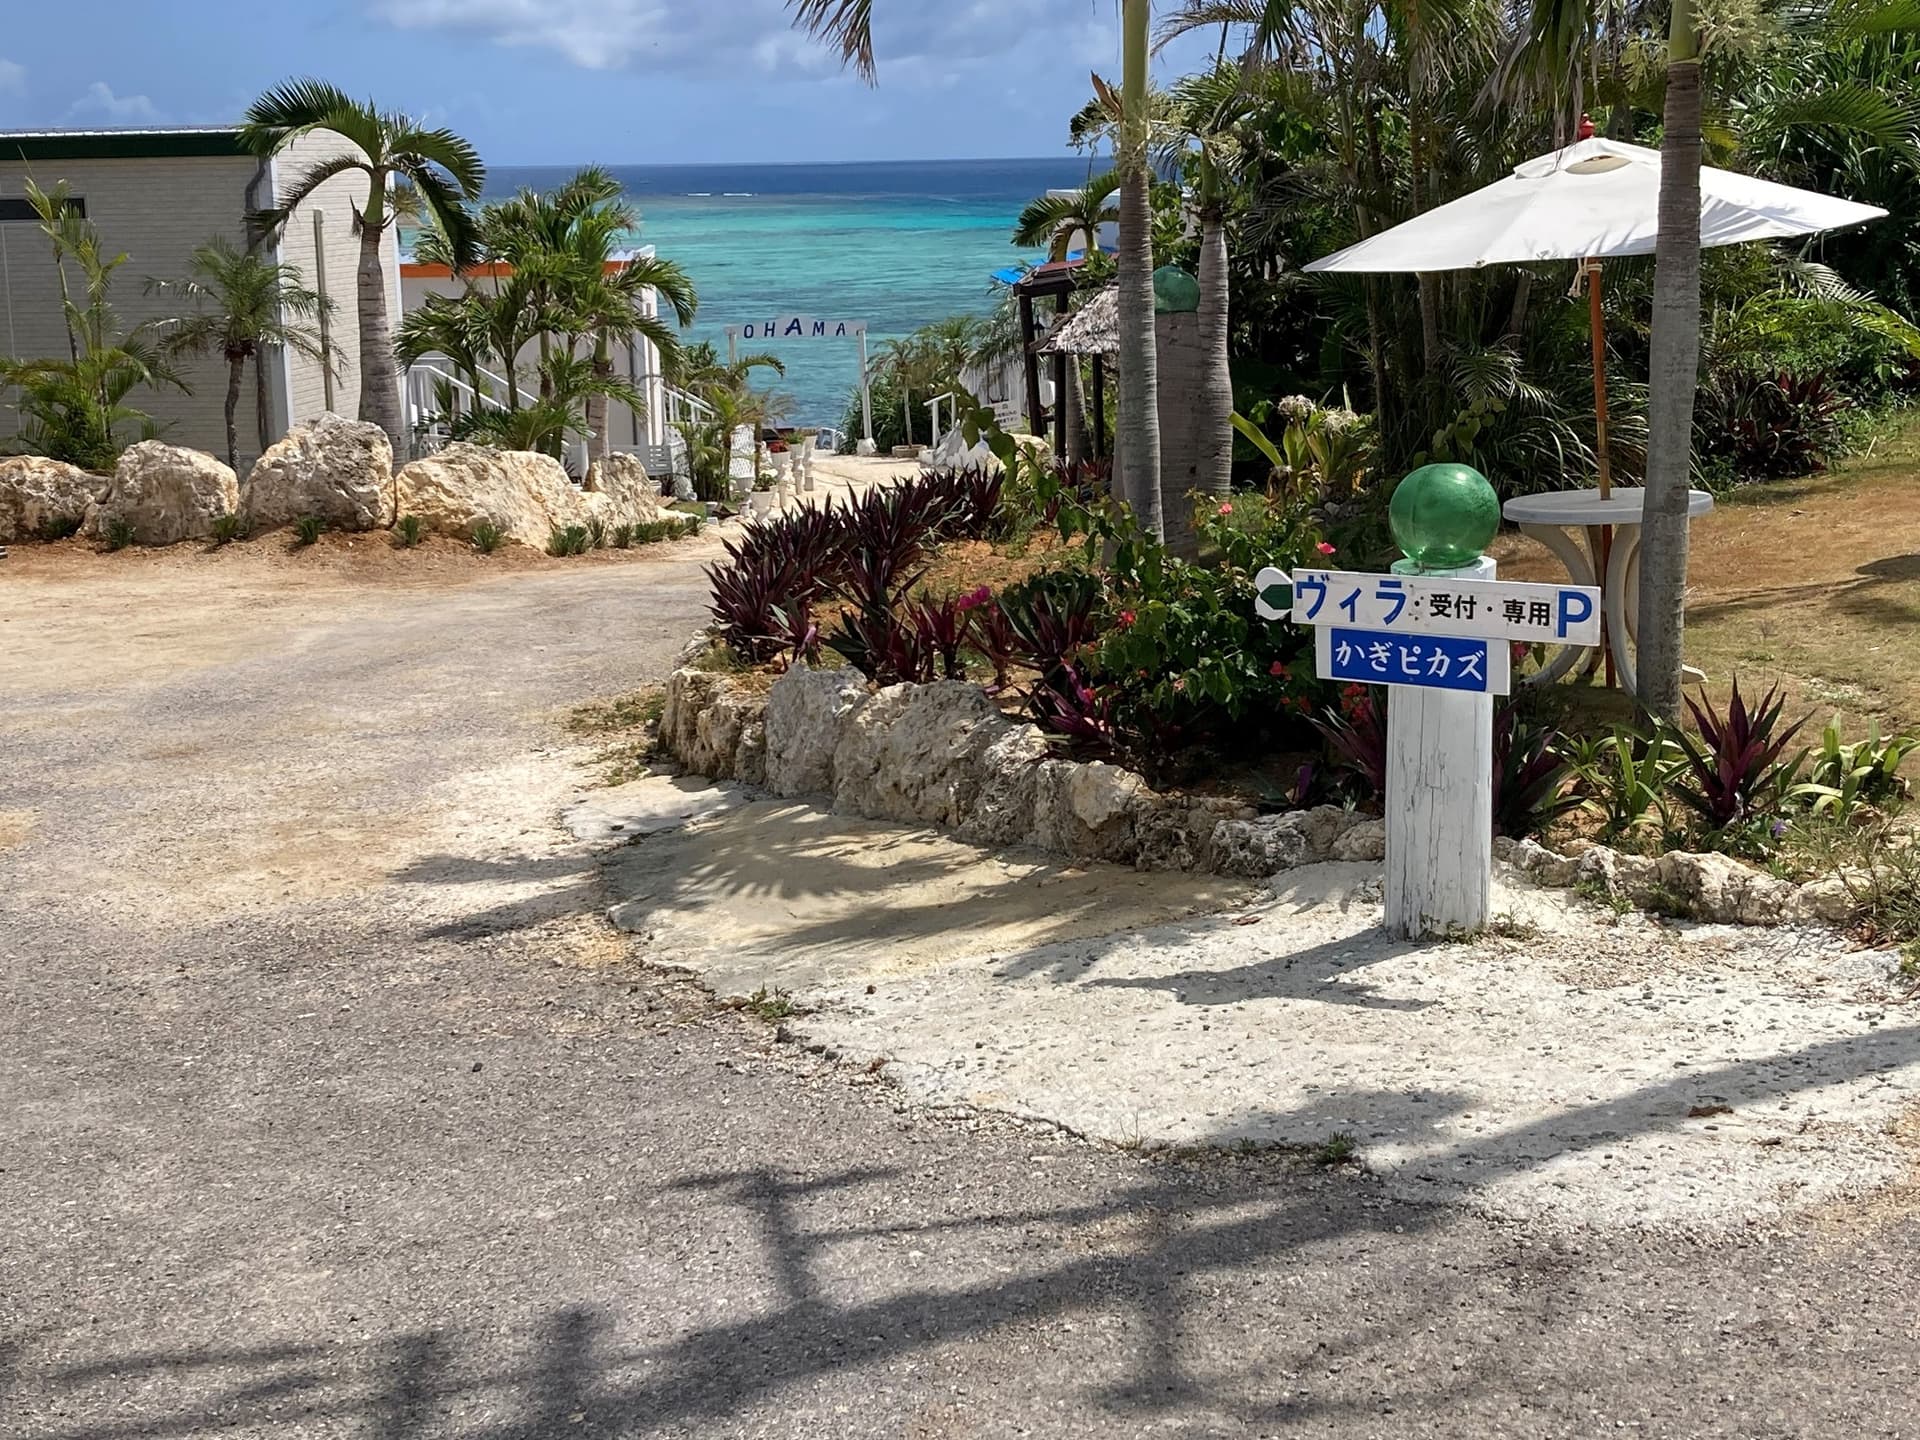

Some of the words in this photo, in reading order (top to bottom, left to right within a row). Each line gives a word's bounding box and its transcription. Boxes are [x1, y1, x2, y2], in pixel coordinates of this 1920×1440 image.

[743, 318, 846, 339] OHAMA
[1335, 640, 1485, 681] かぎピカズ
